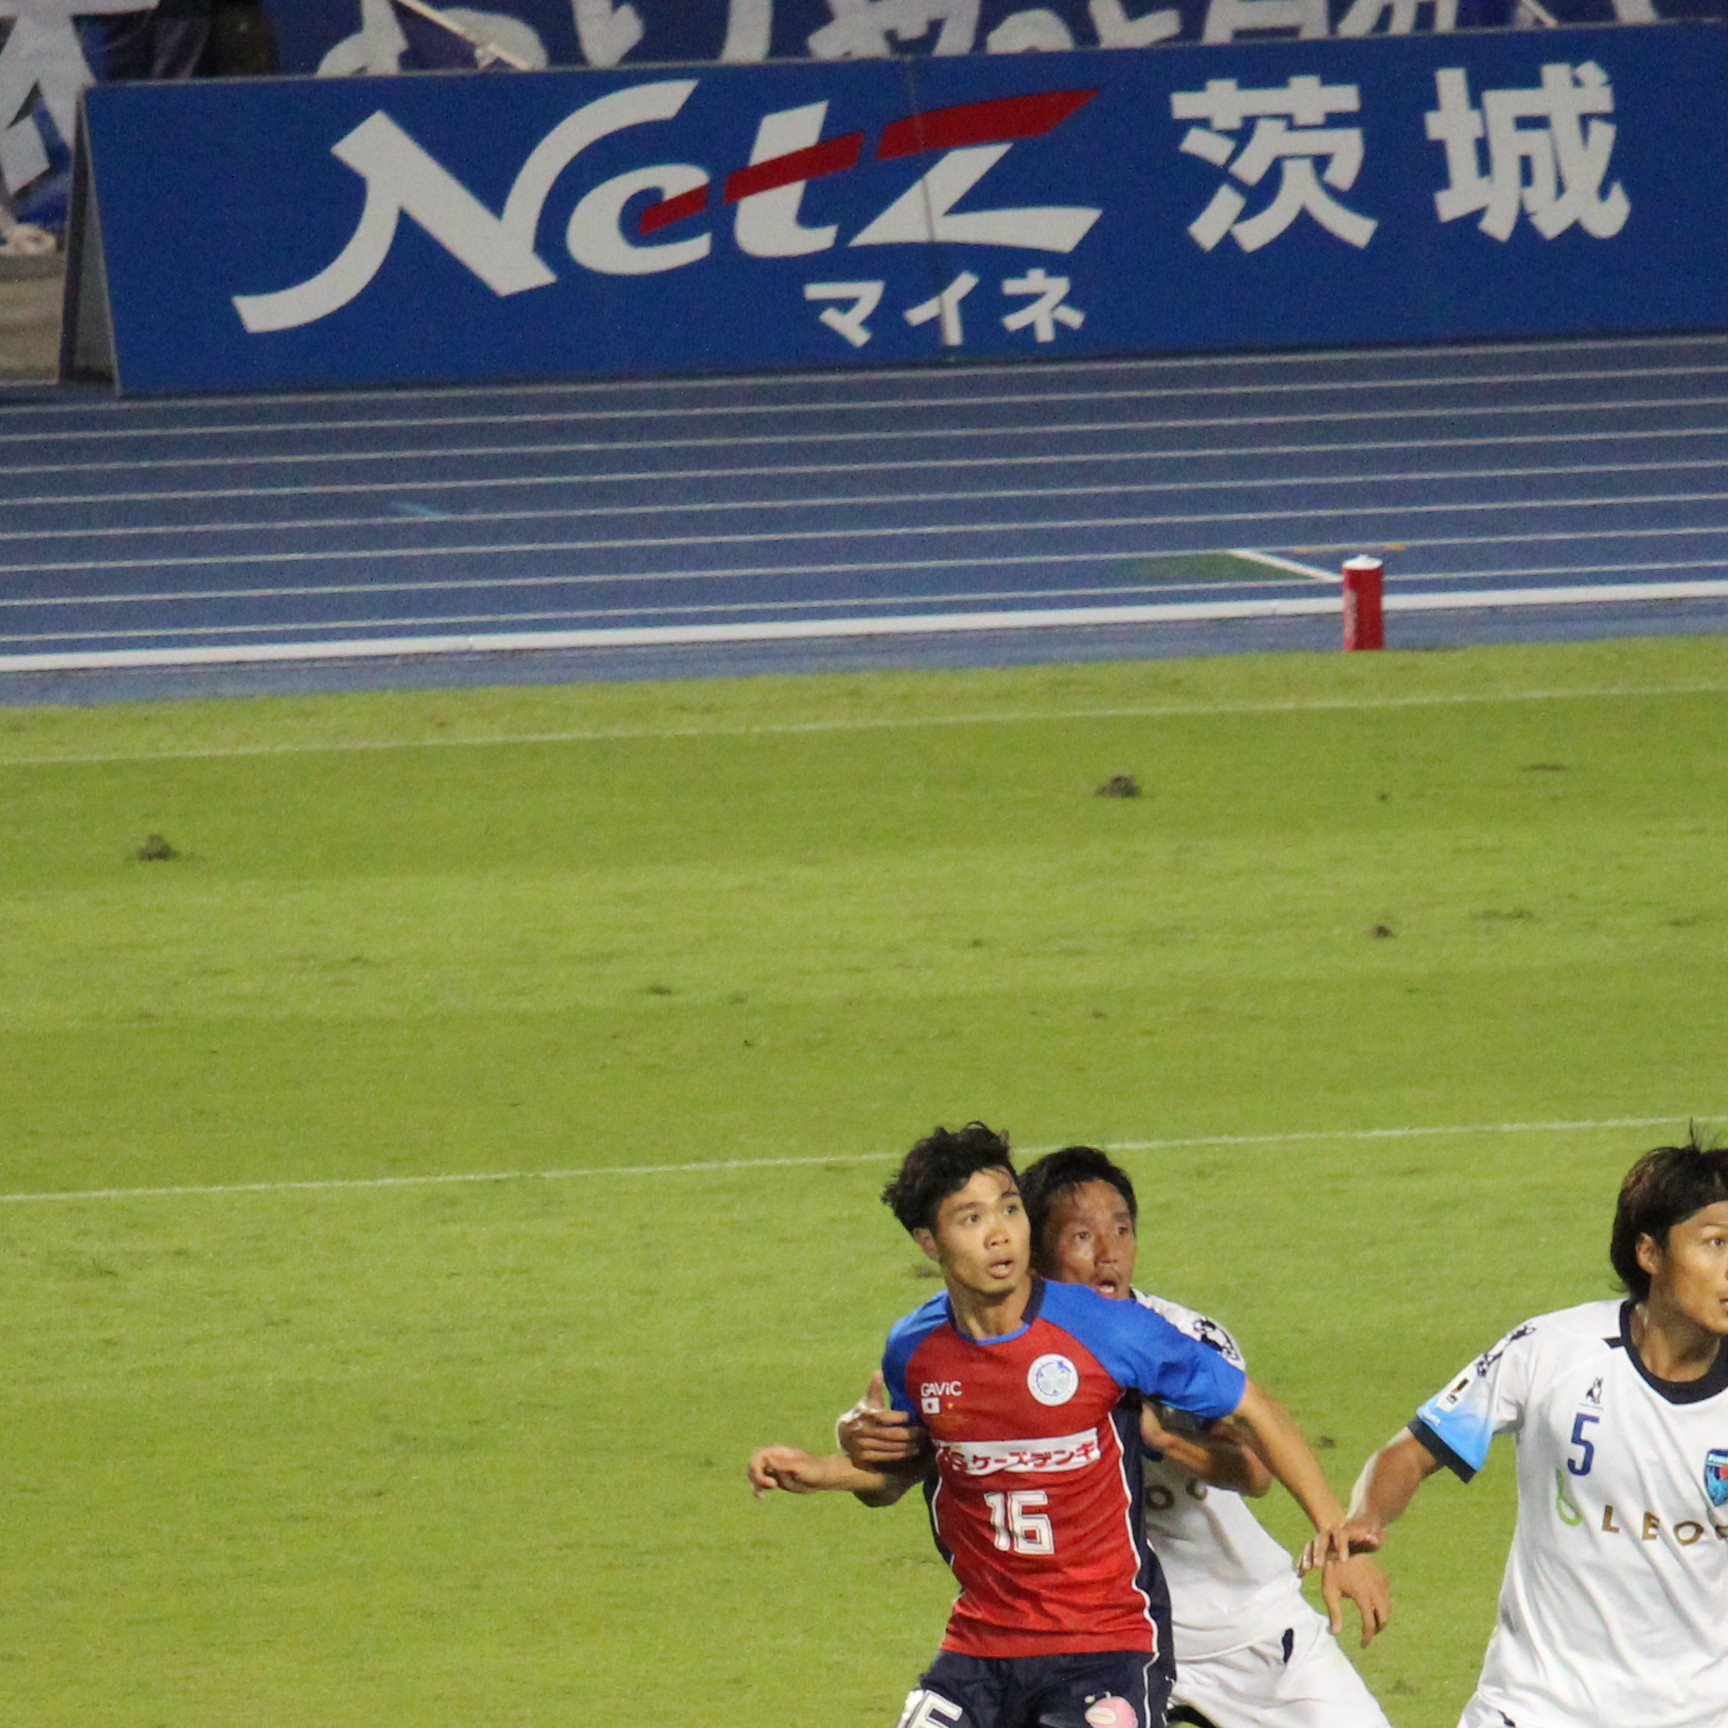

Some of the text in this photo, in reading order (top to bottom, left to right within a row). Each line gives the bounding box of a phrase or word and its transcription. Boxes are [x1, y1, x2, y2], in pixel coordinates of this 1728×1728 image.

[233, 61, 1630, 334] Netz 茨城
[803, 270, 1087, 348] マイネ
[972, 1443, 1096, 1469] ケーズデンキ
[1568, 1413, 1600, 1476] 5
[984, 1491, 1054, 1554] 16
